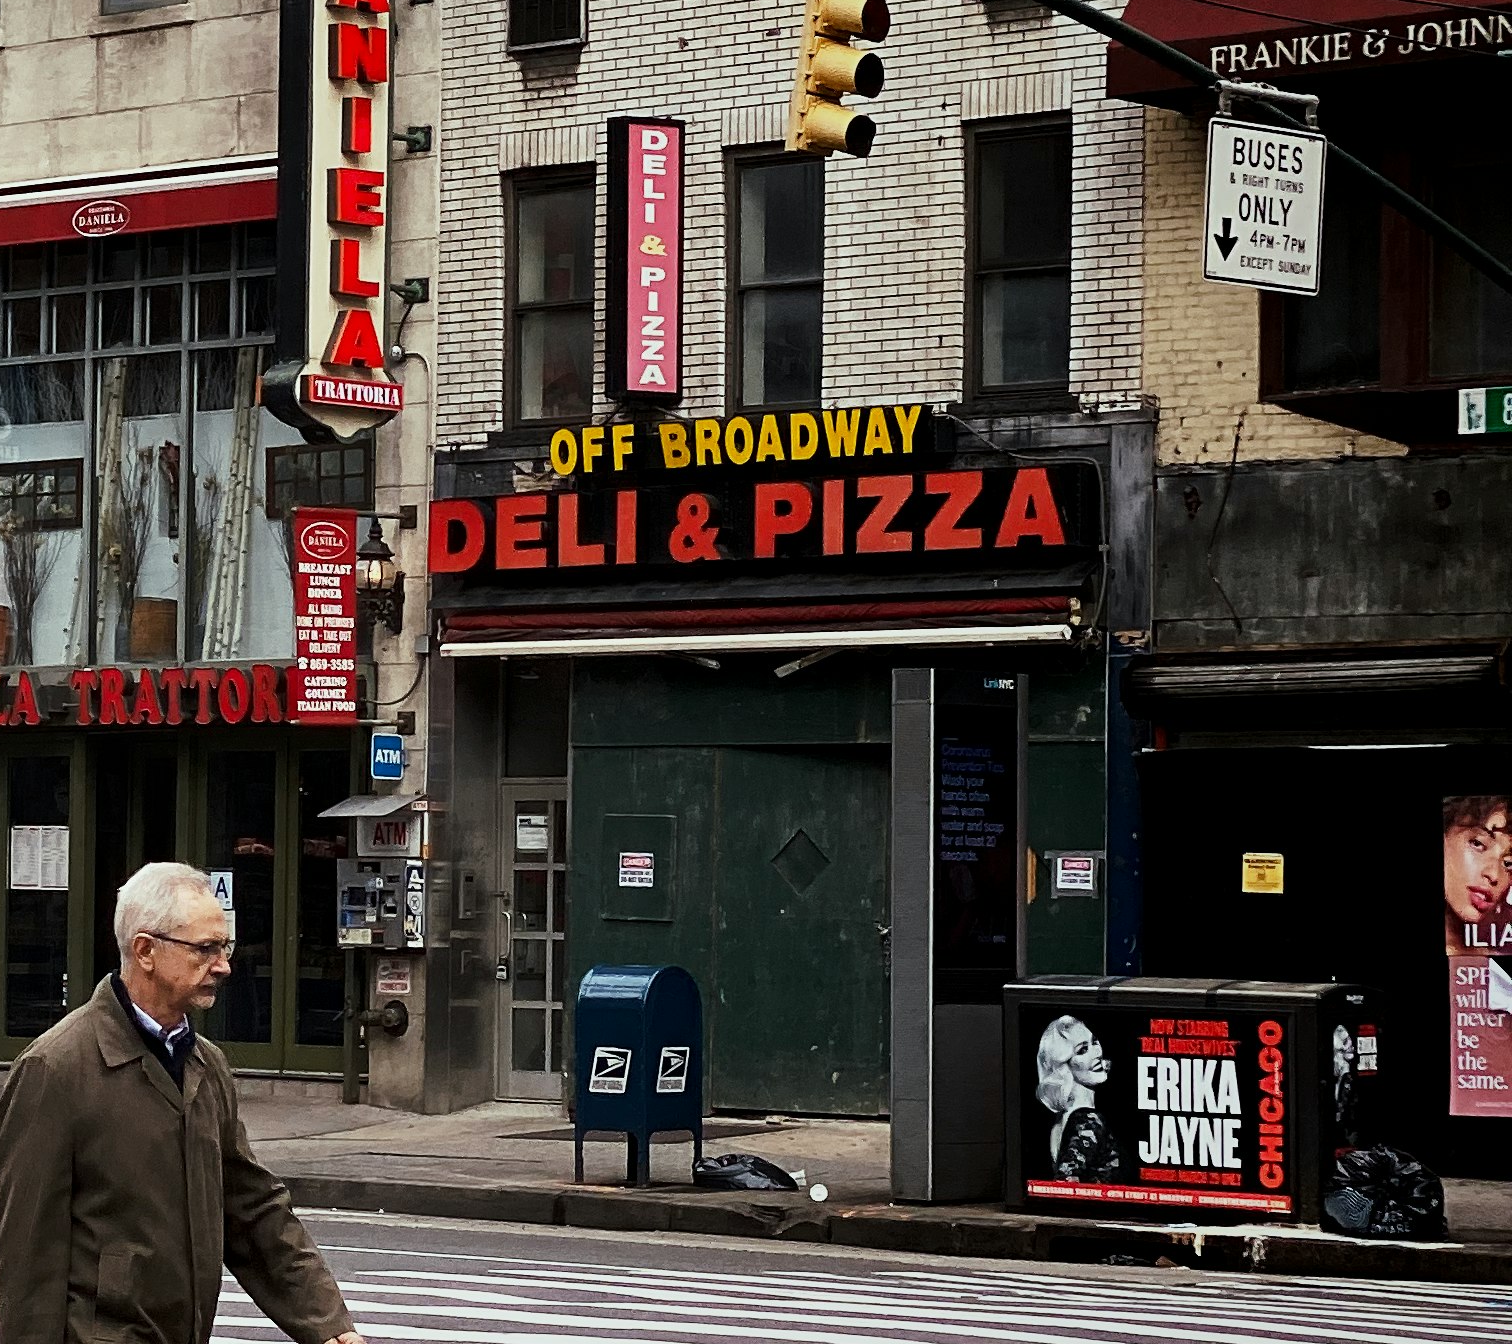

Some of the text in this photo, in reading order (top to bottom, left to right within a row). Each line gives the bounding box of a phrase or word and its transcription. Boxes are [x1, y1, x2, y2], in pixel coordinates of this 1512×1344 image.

[1210, 31, 1352, 74] FRANKIE
[1362, 29, 1390, 58] &
[1232, 137, 1303, 174] BUSES
[640, 129, 668, 225] DELI
[1242, 174, 1270, 188] RIGHT
[1275, 179, 1304, 193] TURNS
[78, 213, 124, 227] DANIELA
[1239, 193, 1293, 227] ONLY
[639, 234, 668, 257] &
[1240, 255, 1312, 275] EXCEPT SUNDAY
[639, 268, 667, 387] PIZZA
[315, 378, 401, 410] TRATTORIA
[551, 405, 923, 477] OFF BROADWAY
[429, 467, 1067, 574] DELI & PIZZA
[308, 536, 345, 547] DANIELA
[298, 562, 352, 575] BREAKFAST
[309, 575, 340, 587] LUNCH
[297, 701, 356, 712] ITALIAN FOOD
[375, 749, 401, 765] ATM
[373, 821, 407, 846] ATM
[215, 877, 228, 898] A
[1456, 989, 1487, 1008] will
[1150, 1019, 1229, 1037] NOW STARRING
[1457, 1012, 1506, 1027] never
[1457, 1030, 1479, 1049] be
[1458, 1052, 1487, 1071] the
[1137, 1056, 1242, 1114] ERIKA
[1458, 1074, 1509, 1089] same.
[1258, 1020, 1284, 1188] CHICAGO
[1138, 1115, 1242, 1168] JAYNE
